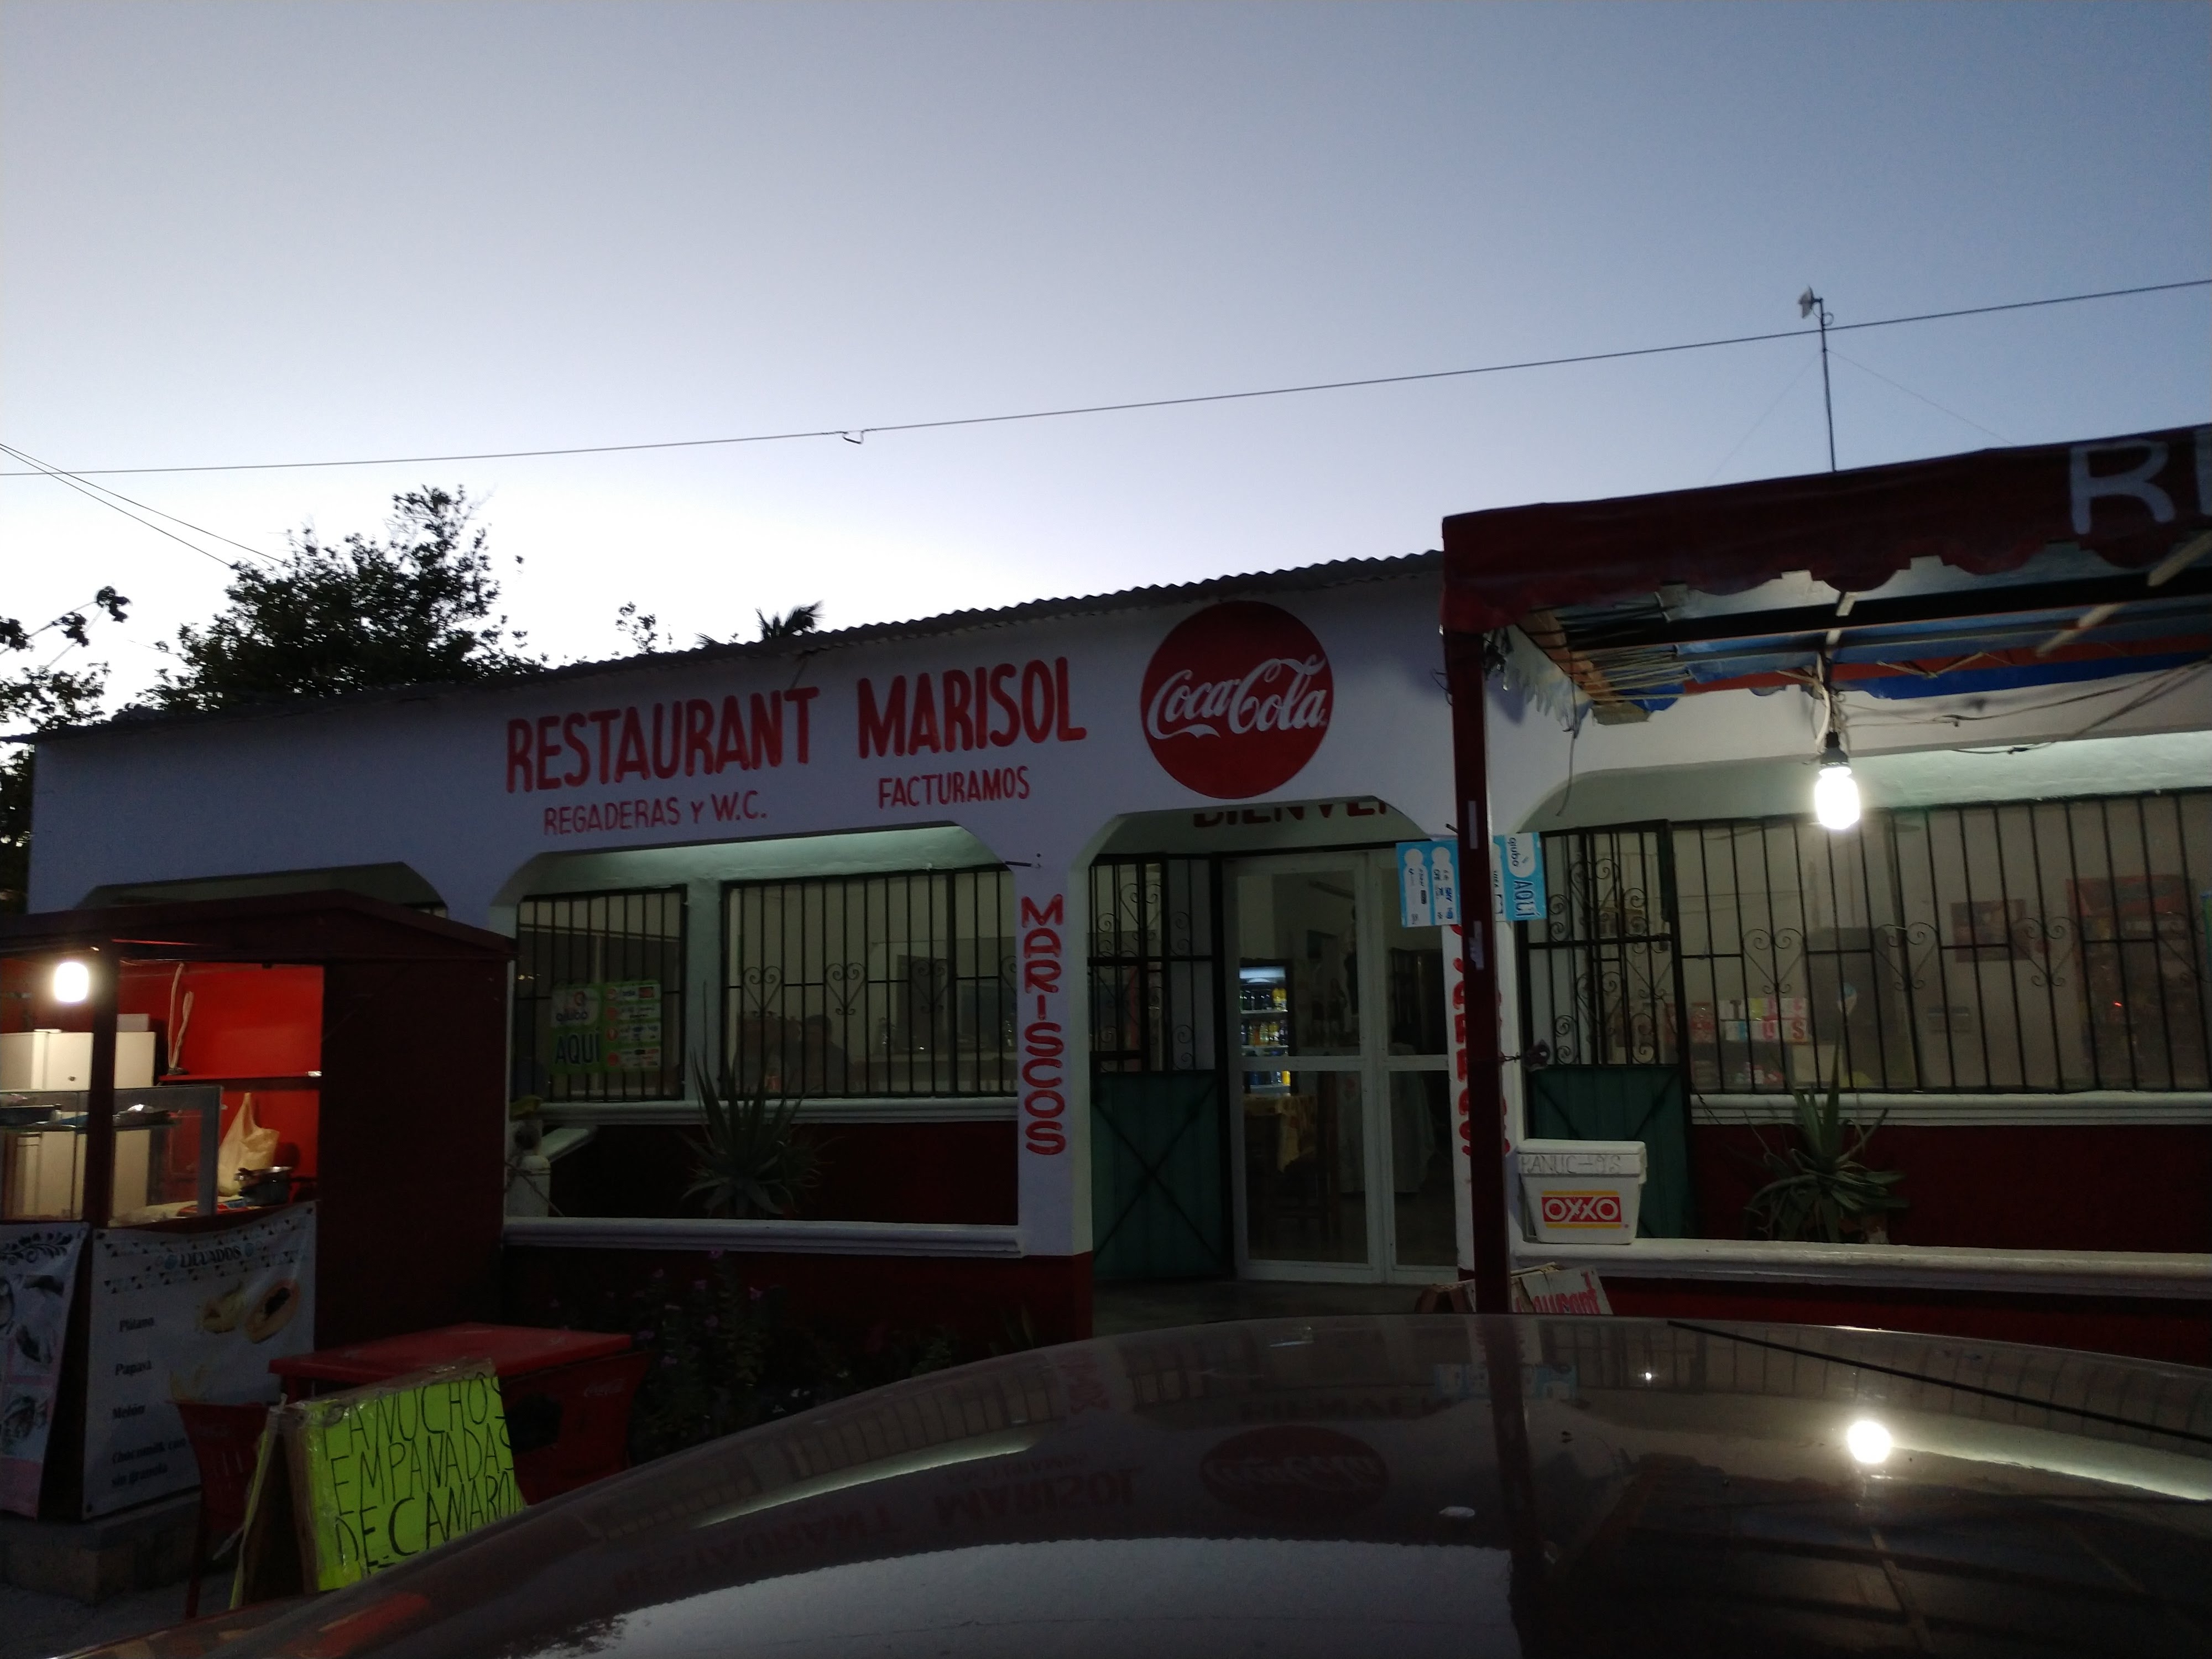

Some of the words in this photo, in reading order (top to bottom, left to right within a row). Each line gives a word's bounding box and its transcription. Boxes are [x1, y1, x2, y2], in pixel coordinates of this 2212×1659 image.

[1146, 655, 1327, 740] Coca-Cola
[507, 686, 820, 792] RESTAURANT
[858, 656, 1087, 759] MARISOL
[878, 766, 1031, 808] FACTURAMOS
[544, 797, 681, 836] REGADERAS
[711, 790, 768, 821] W.C.
[1513, 879, 1541, 918] AQUÍ
[555, 1026, 601, 1065] AQUÍ
[1020, 894, 1067, 1156] MARISCOS
[1543, 1196, 1619, 1222] OXXO
[335, 1505, 380, 1574] DE
